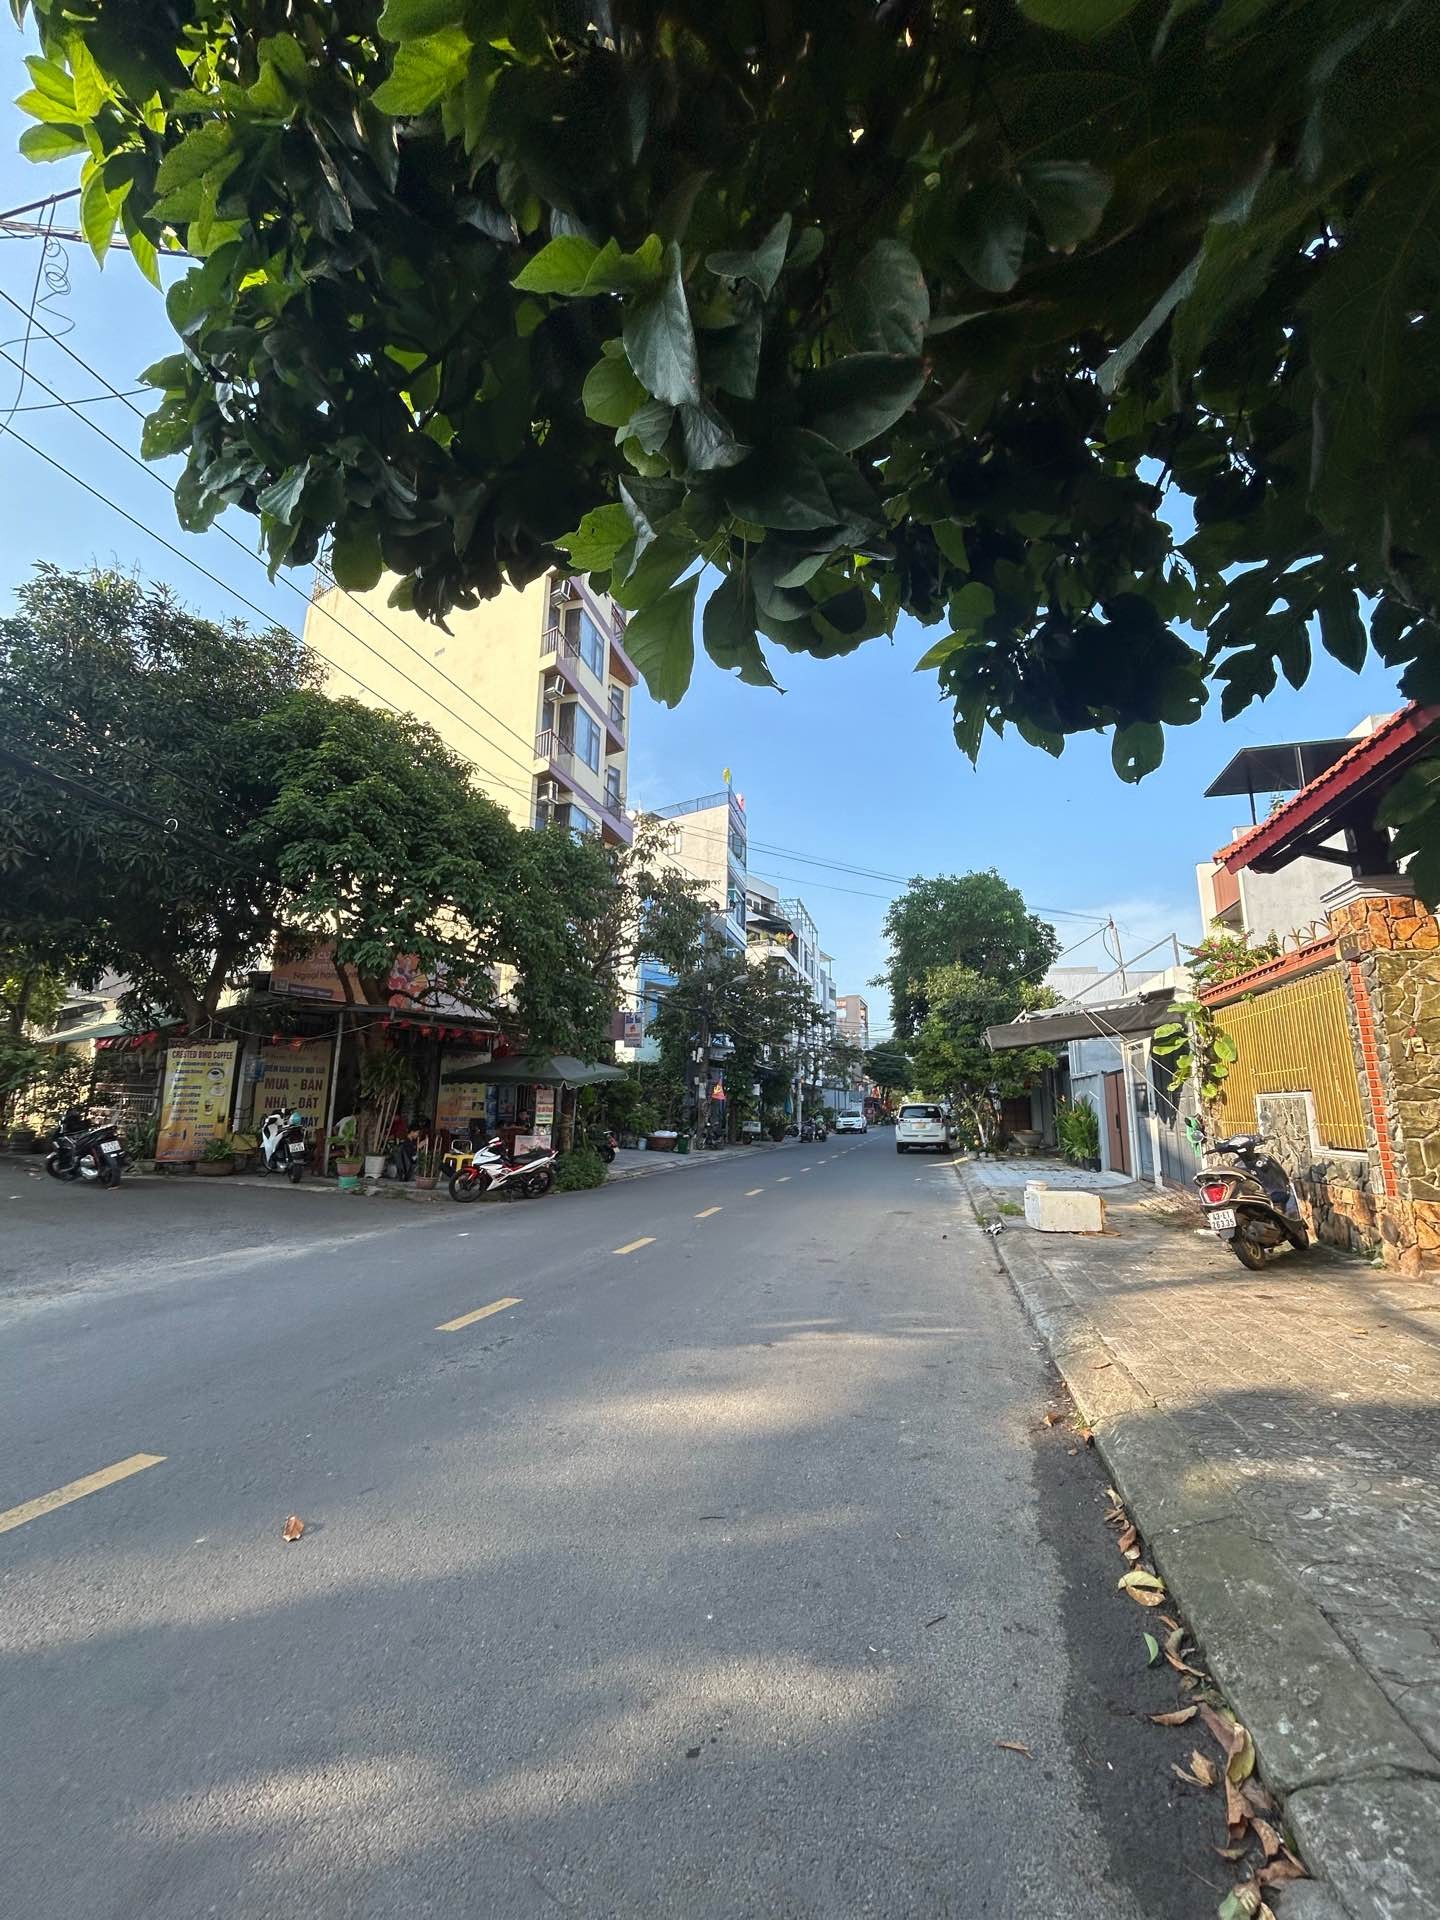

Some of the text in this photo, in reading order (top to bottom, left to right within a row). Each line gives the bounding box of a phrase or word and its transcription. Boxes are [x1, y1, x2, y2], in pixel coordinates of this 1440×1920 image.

[172, 1050, 233, 1060] CRESTED BIRD COFFEE
[264, 1078, 289, 1090] MUA
